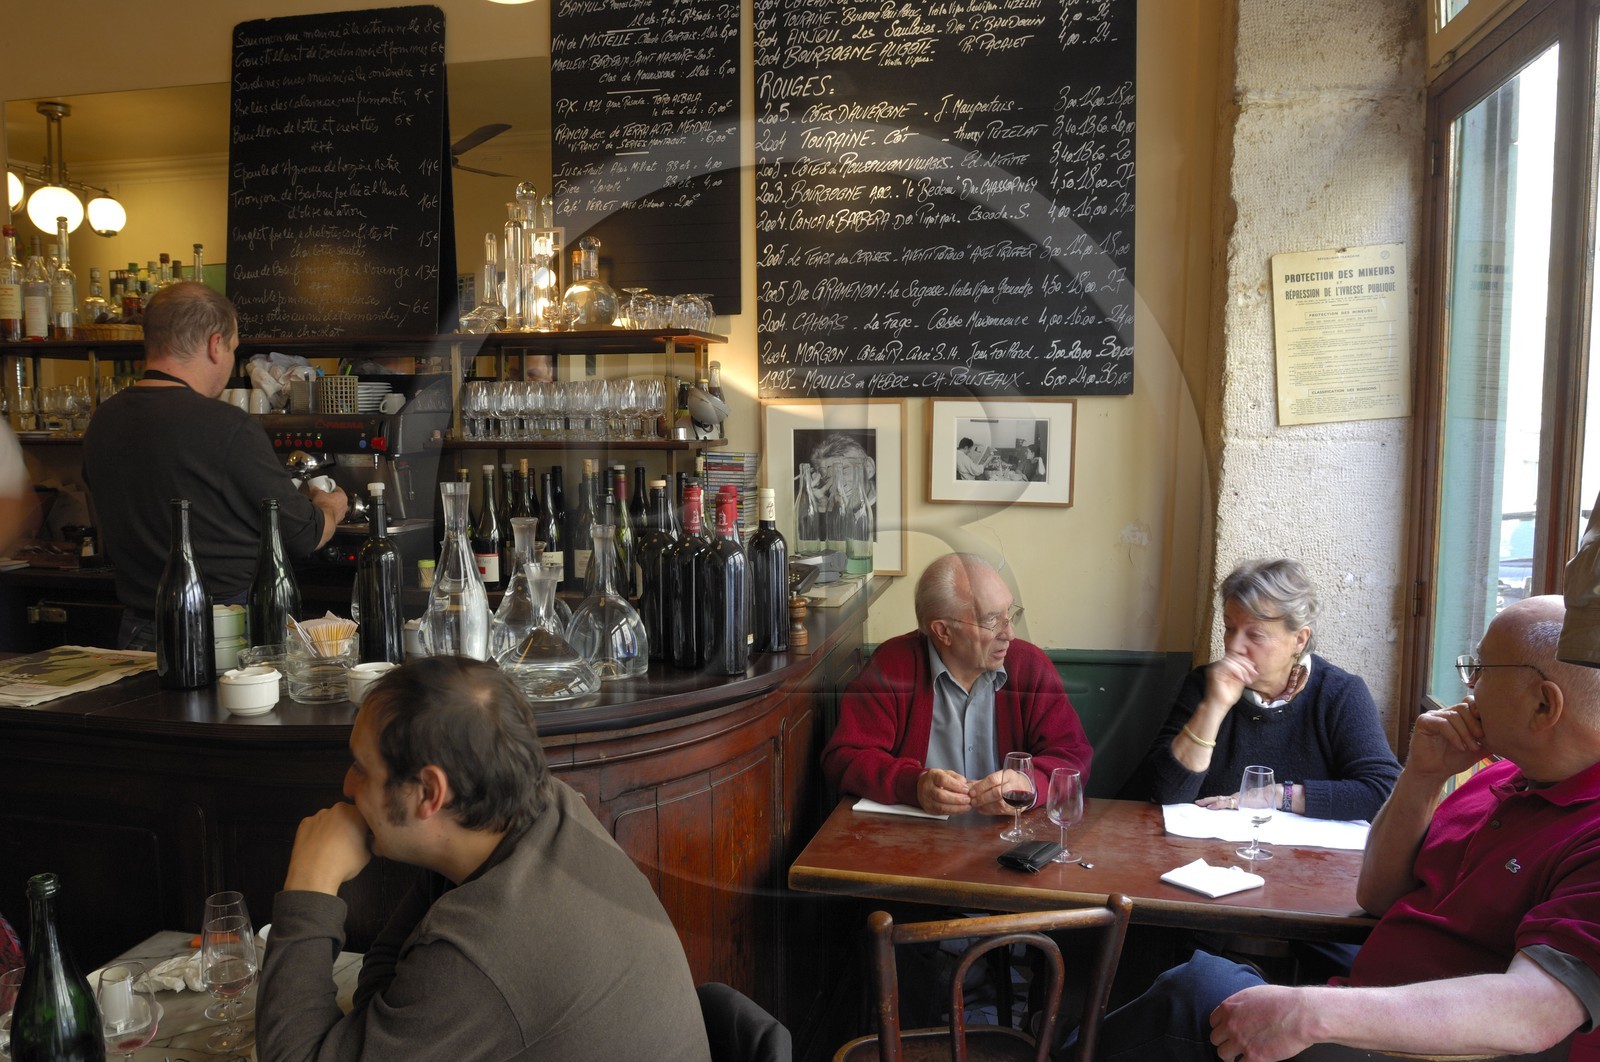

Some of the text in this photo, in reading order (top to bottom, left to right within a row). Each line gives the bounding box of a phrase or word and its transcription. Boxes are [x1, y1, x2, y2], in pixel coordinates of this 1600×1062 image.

[753, 9, 837, 30] 2004 TOURAINE
[753, 31, 778, 48] 2004
[852, 24, 876, 40] Les
[884, 17, 936, 39] Saulaies
[580, 32, 635, 49] MISTELLE
[753, 47, 780, 67] 2004
[783, 43, 882, 70] BOURGOGNE
[976, 33, 1035, 56] PACALET
[757, 102, 791, 125] 2005
[836, 101, 918, 124] D'AUVERGNE
[951, 95, 1015, 121] Maupertuis
[755, 128, 787, 152] 2004
[801, 126, 875, 154] TOURAINE
[756, 156, 785, 180] 2005
[756, 181, 784, 204] 2003
[785, 179, 867, 209] BOURGOGNE
[789, 208, 826, 232] CONCA
[836, 209, 890, 233] BARBERA
[756, 243, 789, 268] 2005
[804, 246, 836, 268] TEMPS
[849, 249, 893, 266] CERISES
[1285, 265, 1396, 284] PROTECTION DES MINEURS
[756, 280, 789, 303] 2005
[1285, 288, 1320, 301] RÉPRESSION
[1324, 287, 1332, 297] DE
[1335, 284, 1364, 297] L'IVRESSE
[1368, 282, 1396, 294] PUBLIQUE
[792, 311, 849, 337] CAHORS
[883, 311, 912, 339] Fage
[794, 340, 849, 367] MORGON
[965, 340, 989, 369] Jean
[989, 339, 1034, 360] Foillard
[759, 368, 796, 391] 1998
[802, 368, 856, 397] MOULIS
[949, 366, 1025, 392] POUJEAUX
